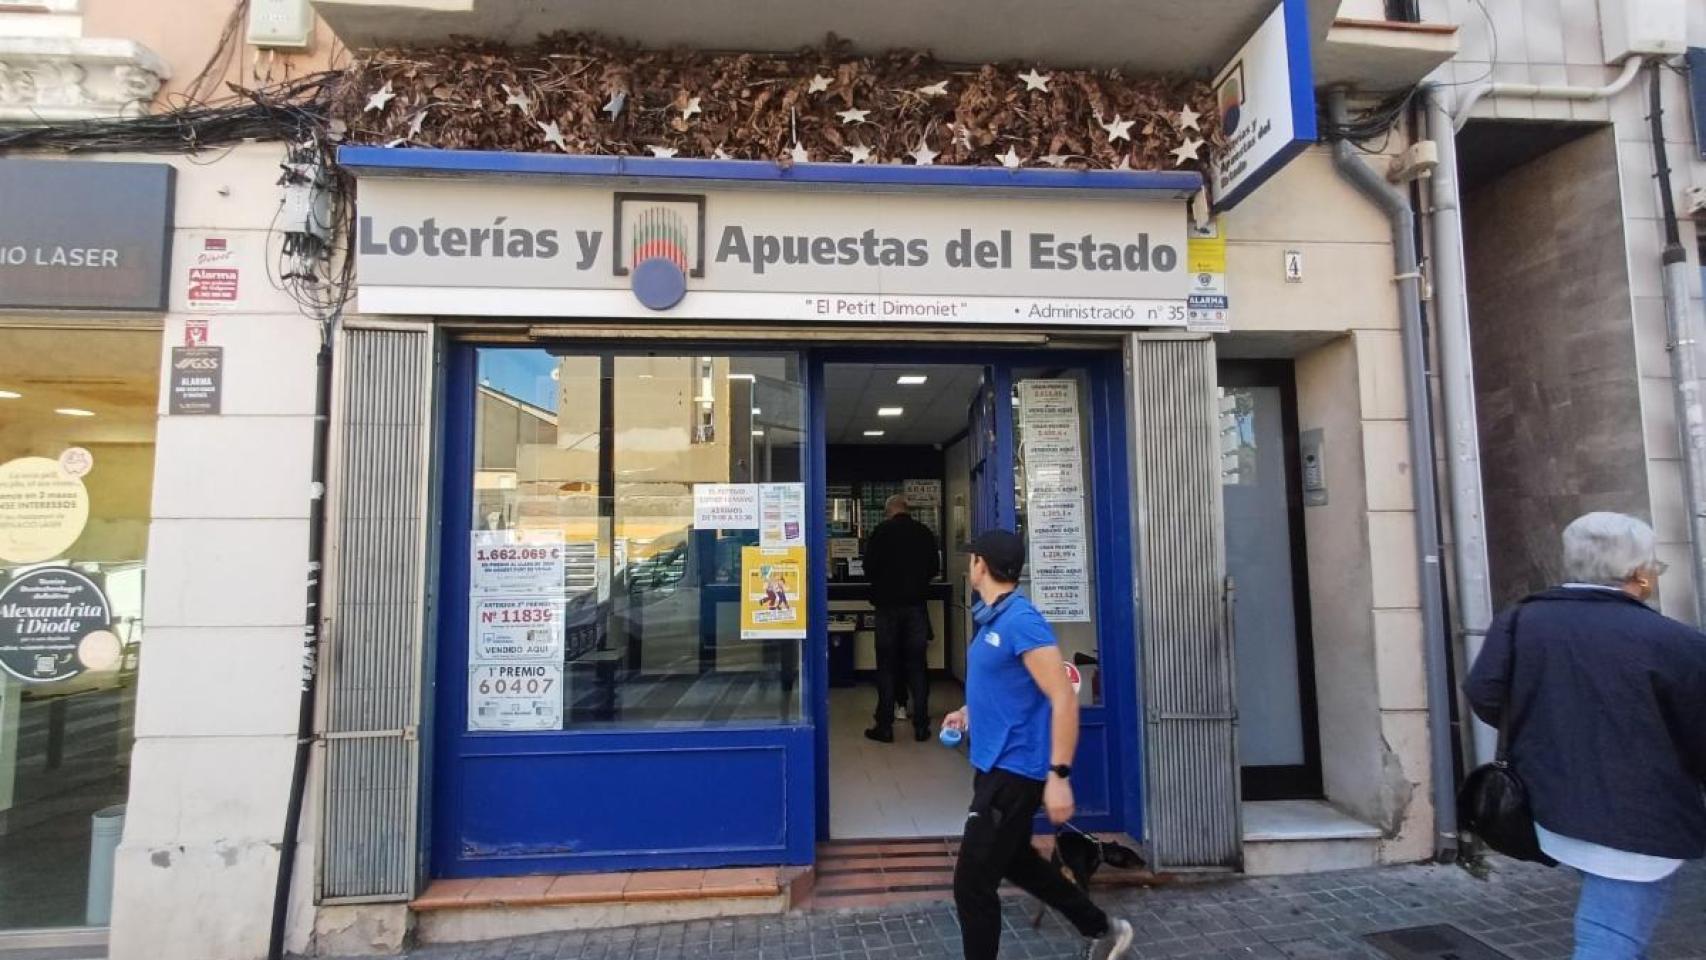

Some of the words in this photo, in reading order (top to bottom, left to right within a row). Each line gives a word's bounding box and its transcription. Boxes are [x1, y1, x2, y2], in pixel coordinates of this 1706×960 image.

[360, 215, 560, 259] Loterías
[575, 230, 604, 271] y
[714, 225, 929, 274] Apuestas
[944, 228, 1012, 269] del
[1029, 232, 1178, 273] Estado
[36, 246, 119, 267] LASER
[1288, 255, 1299, 276] 4
[190, 269, 237, 280] Alarma
[1189, 295, 1225, 304] ALARMA
[836, 300, 876, 316] Petit
[1027, 302, 1135, 320] Administració
[1168, 305, 1186, 322] 35
[477, 548, 547, 561] 1.662.069
[0, 602, 102, 618] Alexandrita
[501, 608, 553, 623] 11839
[16, 618, 25, 634] i
[26, 618, 81, 634] Diode
[485, 646, 523, 654] VENDIDO
[499, 666, 546, 678] PREMIO
[479, 679, 555, 695] 60407
